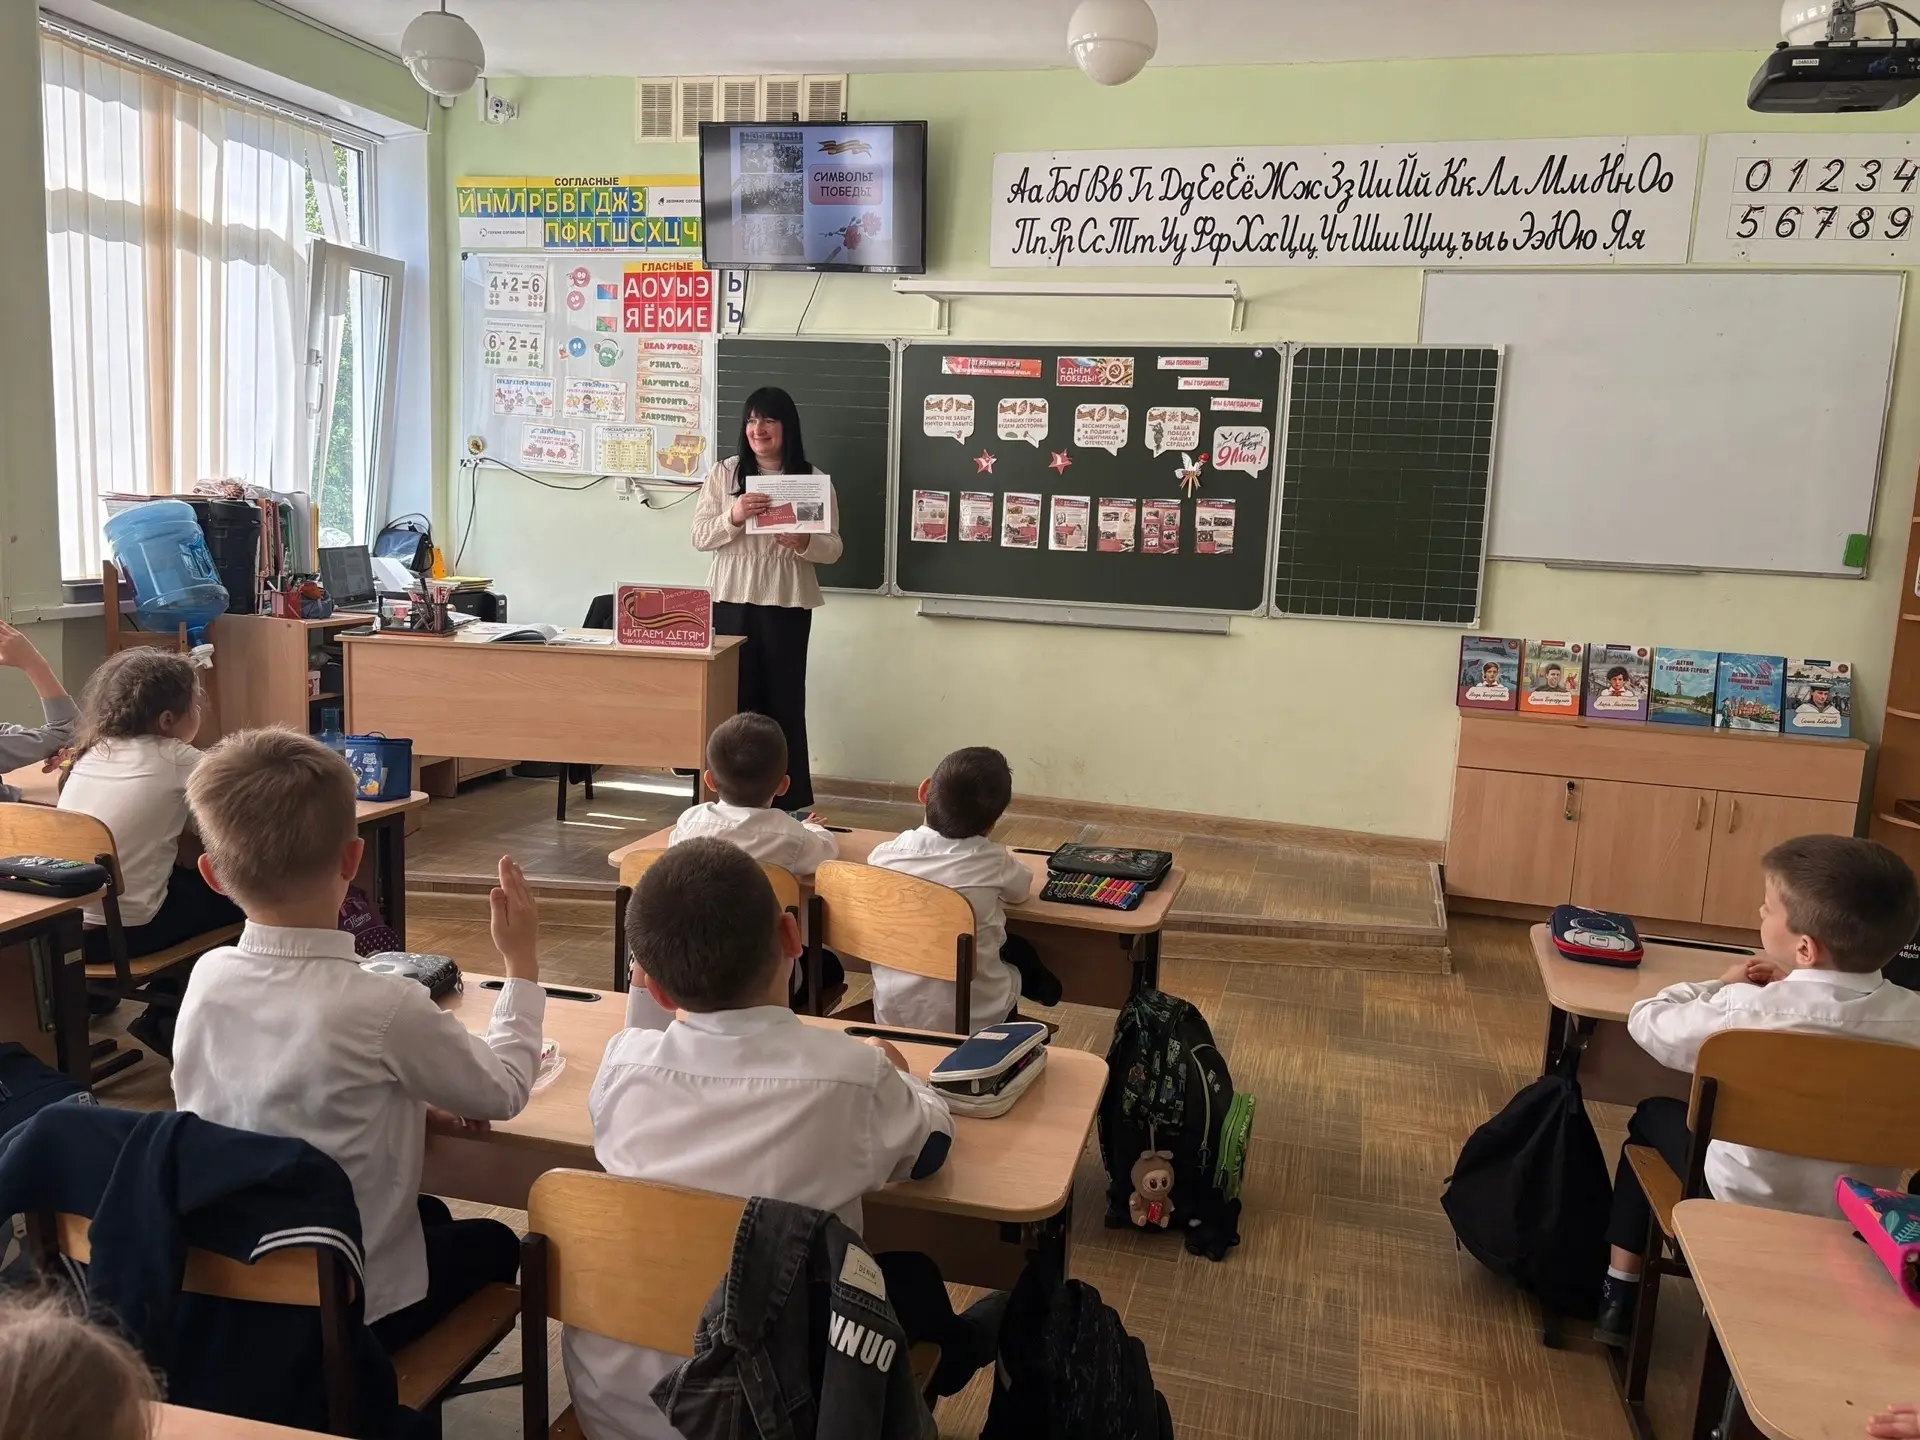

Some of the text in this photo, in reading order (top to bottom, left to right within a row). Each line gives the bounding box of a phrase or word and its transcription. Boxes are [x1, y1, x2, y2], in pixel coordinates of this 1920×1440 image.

[813, 171, 874, 182] СИМВОЛЫ
[1745, 158, 1919, 192] 0 1 2 3 4
[554, 177, 620, 186] СОГЛАСНЫЕ
[1007, 151, 1674, 217] Аа Бб Вв Гг Дд Ее Ёё Жж Зз Ии Йй Кк Лл Мм Нн Оо
[820, 186, 872, 198] ПОБЕДЫ
[1736, 205, 1912, 240] 5 6 7 8 9
[1012, 217, 1048, 254] Пп
[1049, 217, 1075, 266] Рр
[1078, 217, 1106, 254] Сс
[1105, 217, 1158, 254] Тт
[1159, 215, 1188, 266] Уу
[1191, 215, 1233, 266] Фф
[1232, 214, 1280, 252] Хх
[1280, 213, 1318, 259] Цц
[1320, 213, 1351, 252] Чч
[1350, 213, 1401, 252] Шш
[1401, 212, 1459, 259] Щщ
[1512, 211, 1548, 251] Ээ
[1546, 209, 1598, 250] Юю
[1602, 208, 1646, 250] Яя
[642, 262, 694, 271] ГЛАСНЫЕ
[490, 276, 498, 290] 4
[510, 277, 519, 292] 2
[508, 336, 517, 351] 2
[529, 337, 538, 352] 4
[643, 342, 665, 350] ЦЕЛЬ
[978, 360, 1006, 368] ВЕЛИКИЙ
[1175, 359, 1202, 367] ПОМНИМ!
[1059, 374, 1098, 383] ПОБЕДЫ!
[1183, 379, 1225, 388] МЫ ГОРДИМСЯ!
[1212, 400, 1223, 408] МЫ
[1215, 446, 1267, 467] 9 Мая!
[622, 628, 705, 641] ЧИТАЕМ ДЕТЯМ
[1898, 951, 1920, 959] 48pcs
